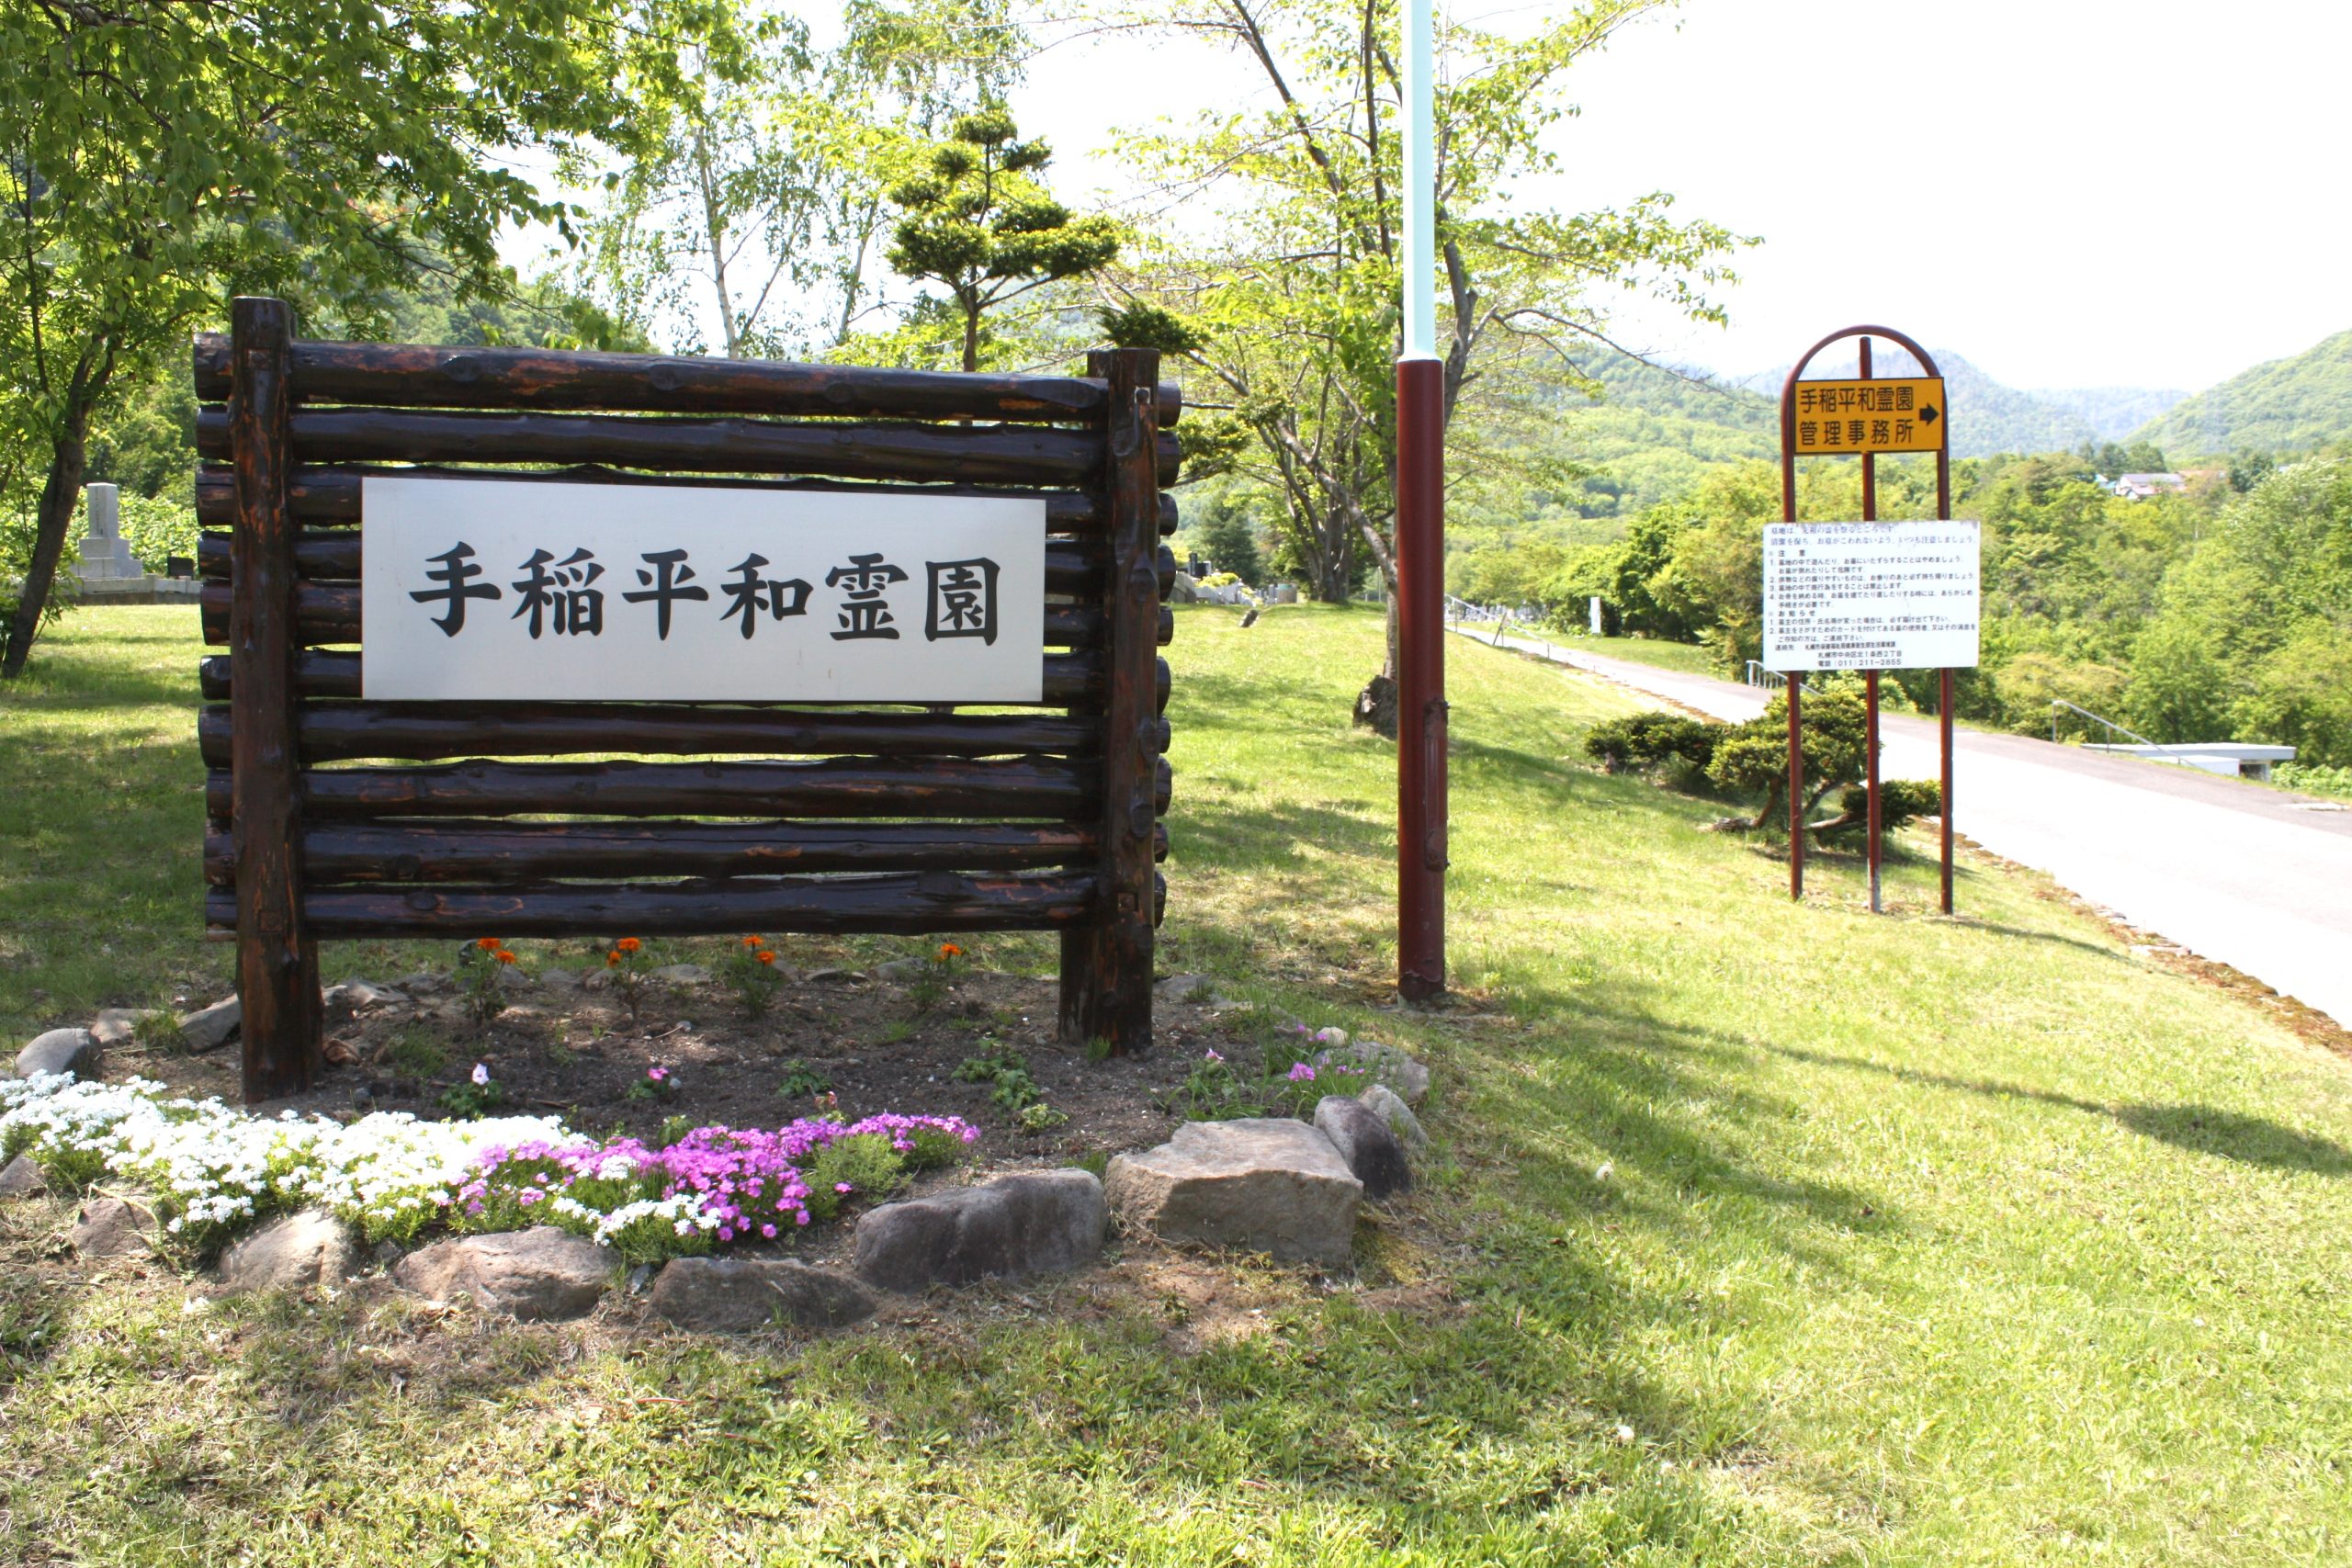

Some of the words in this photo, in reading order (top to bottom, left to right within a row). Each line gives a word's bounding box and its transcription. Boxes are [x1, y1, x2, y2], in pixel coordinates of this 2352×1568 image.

[1800, 386, 1913, 413] 手稲平和霊園
[1800, 418, 1914, 446] 管理事務所
[408, 540, 1001, 647] 手稲平和霊園
